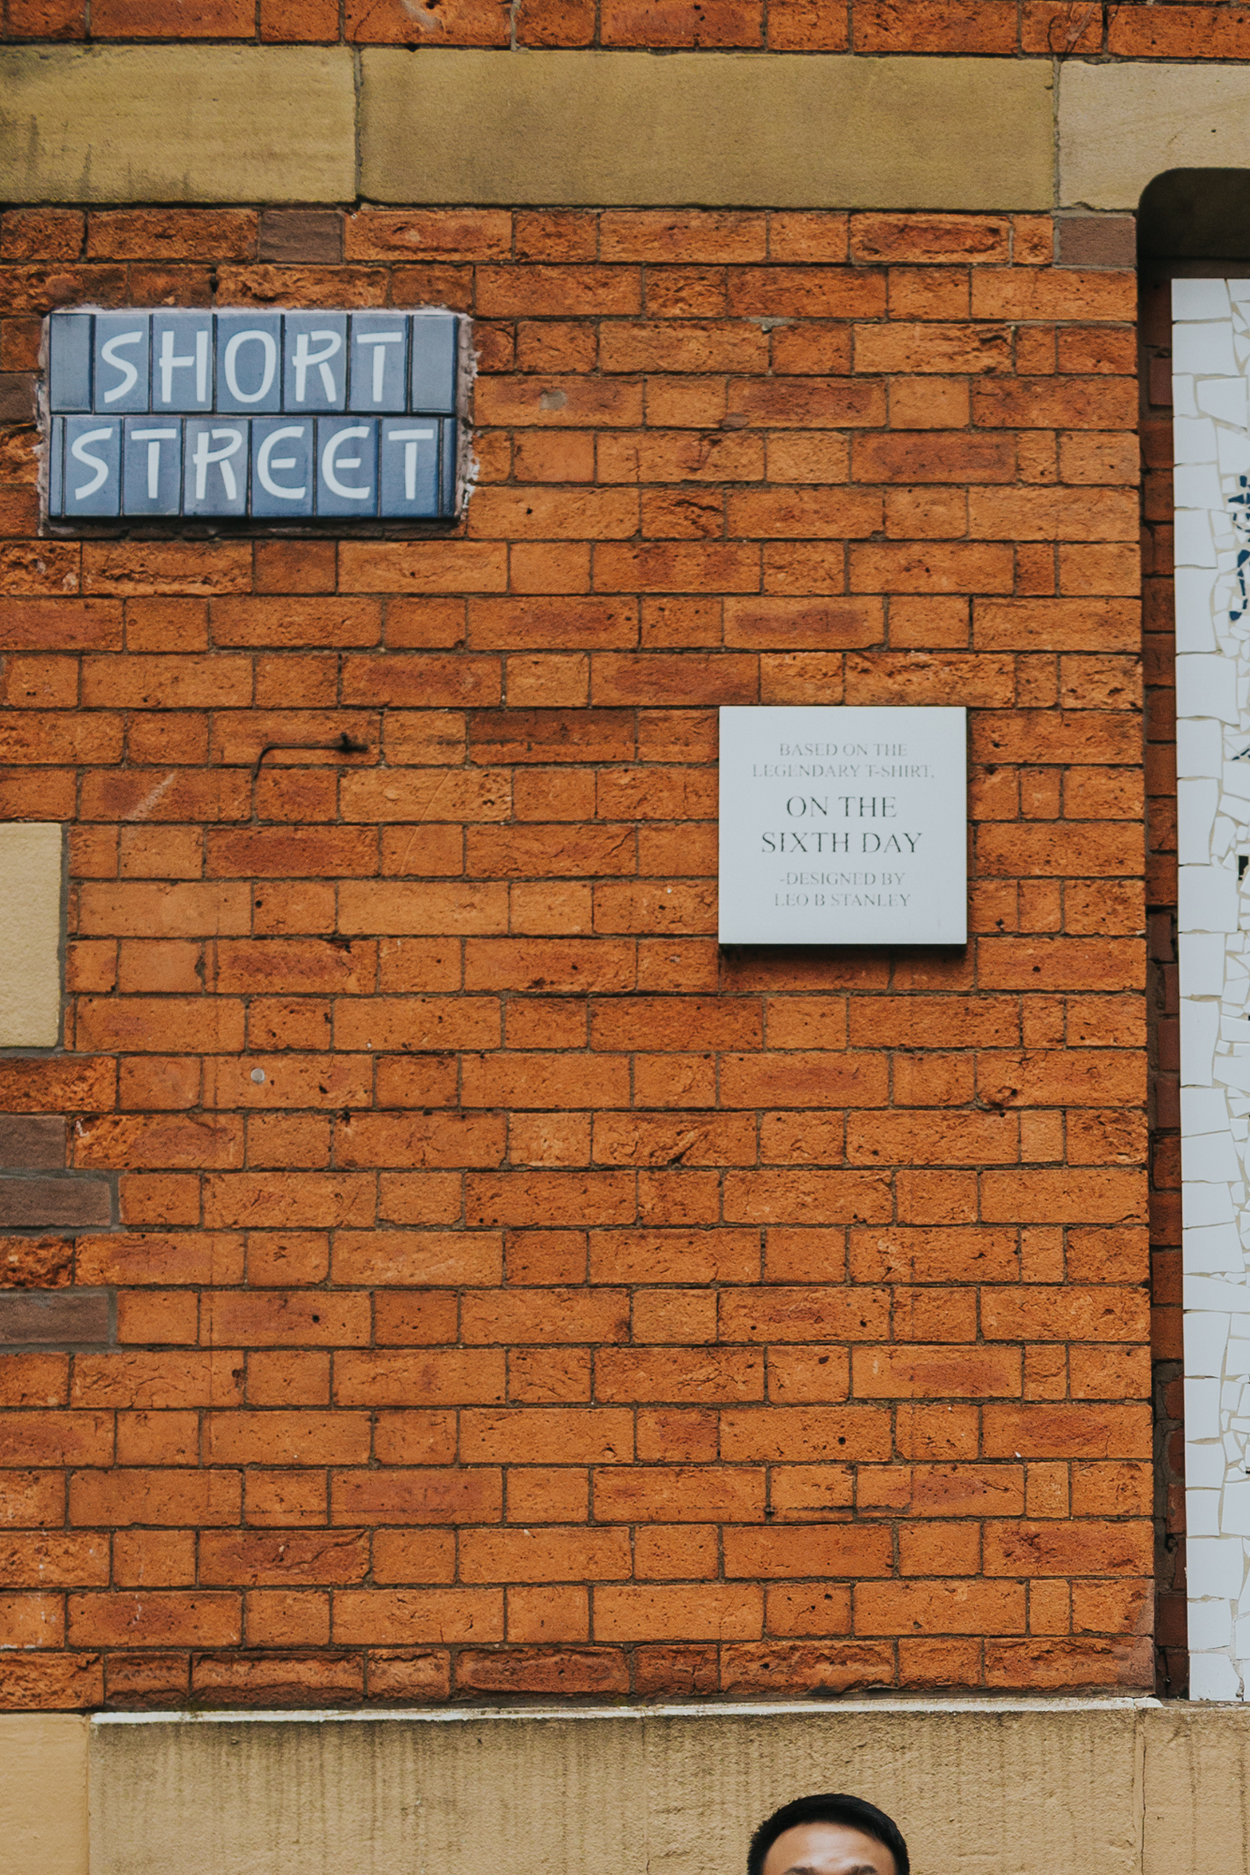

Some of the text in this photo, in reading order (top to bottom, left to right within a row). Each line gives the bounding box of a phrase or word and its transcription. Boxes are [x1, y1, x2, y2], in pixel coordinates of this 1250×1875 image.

[102, 330, 403, 404] SHORT
[72, 427, 434, 501] STREET
[779, 743, 908, 757] BASED ON THE
[752, 764, 860, 778] LEGENDARY
[786, 796, 898, 818] ON THE
[761, 832, 923, 854] SIXTH DAY
[881, 872, 906, 886] BY
[774, 893, 912, 907] LEO B STANLEY
